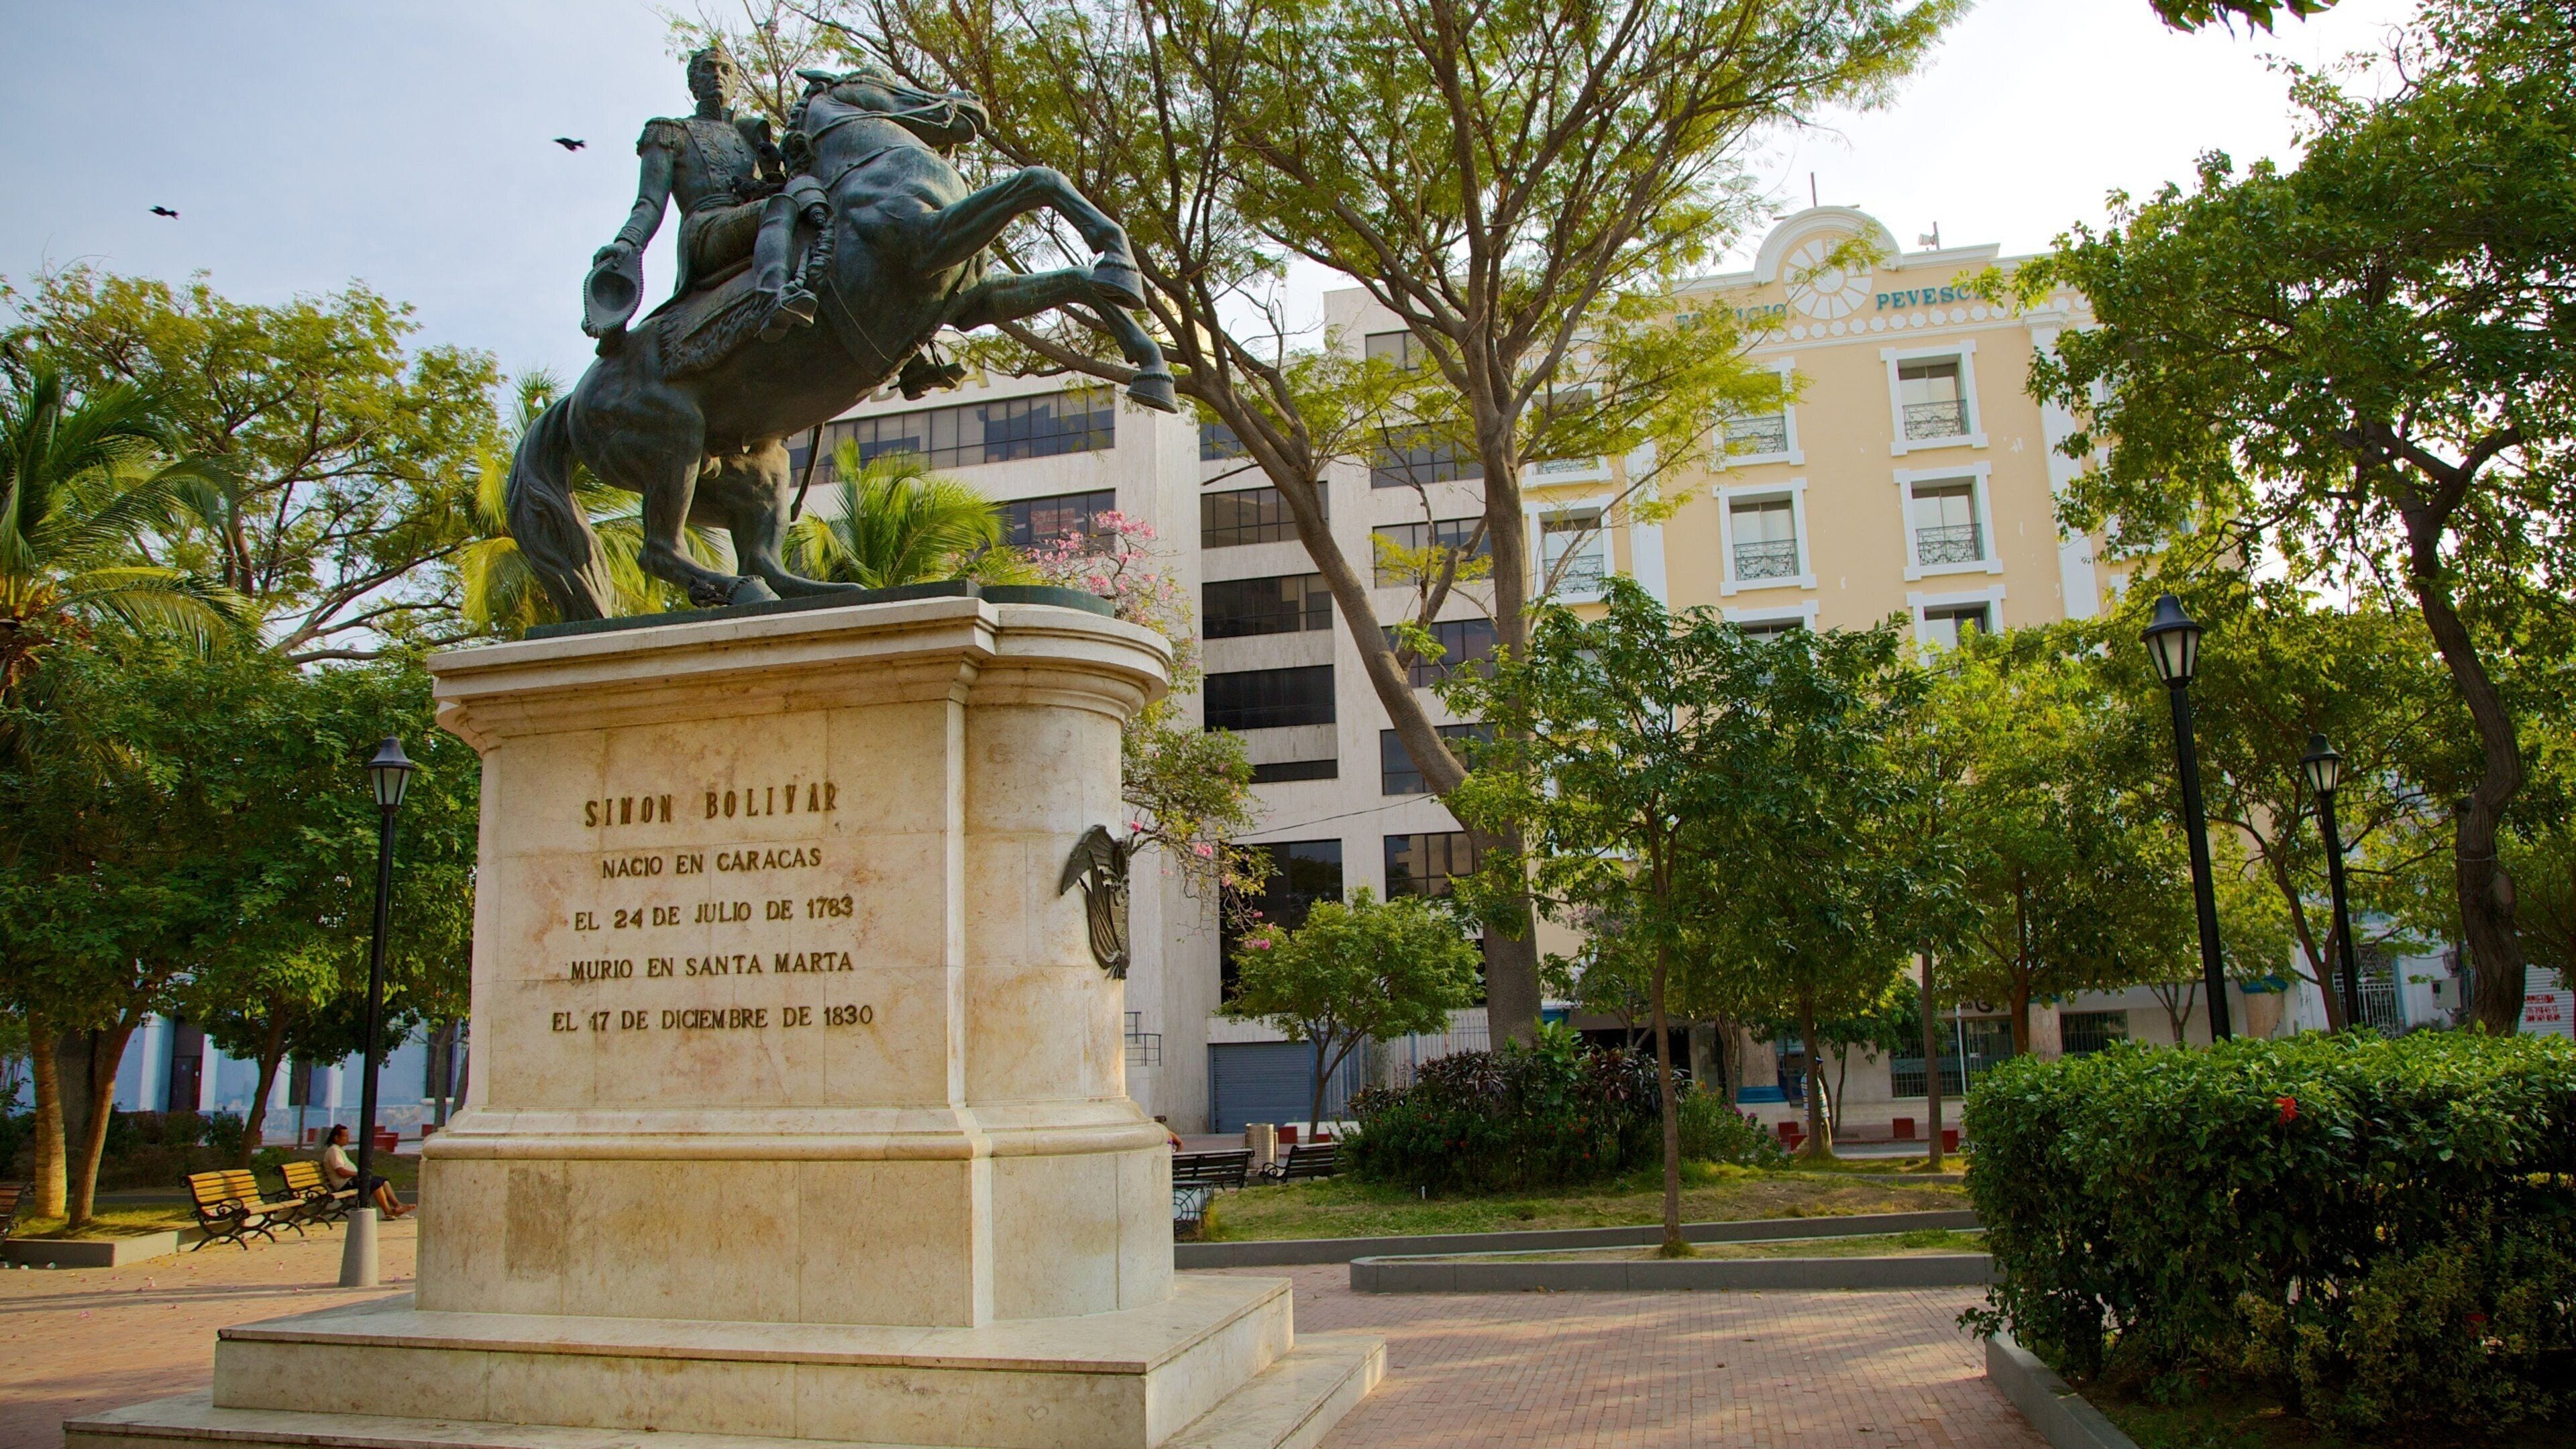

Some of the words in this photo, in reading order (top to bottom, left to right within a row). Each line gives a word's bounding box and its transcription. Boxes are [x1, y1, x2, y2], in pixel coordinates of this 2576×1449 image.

[585, 794, 672, 827] SIMON
[706, 782, 838, 819] BOLIVAR
[602, 857, 663, 879] NACIO
[676, 854, 704, 874] EN
[716, 848, 822, 871] CARACAS
[575, 912, 600, 930] EL
[614, 909, 643, 929] 24
[653, 906, 680, 926] DE
[694, 902, 751, 923] JULIO
[766, 900, 794, 920] DE
[807, 894, 853, 918] 1783
[571, 960, 633, 980] MURIO
[647, 958, 674, 977] EN
[686, 955, 763, 976] SANTA
[775, 952, 854, 973] MARTA
[552, 1012, 578, 1031] EL
[590, 1012, 610, 1031] 17
[621, 1011, 649, 1030] DE
[661, 1008, 768, 1030] DICIEMBRE
[783, 1007, 812, 1027] DE
[824, 1006, 873, 1026] 1830
